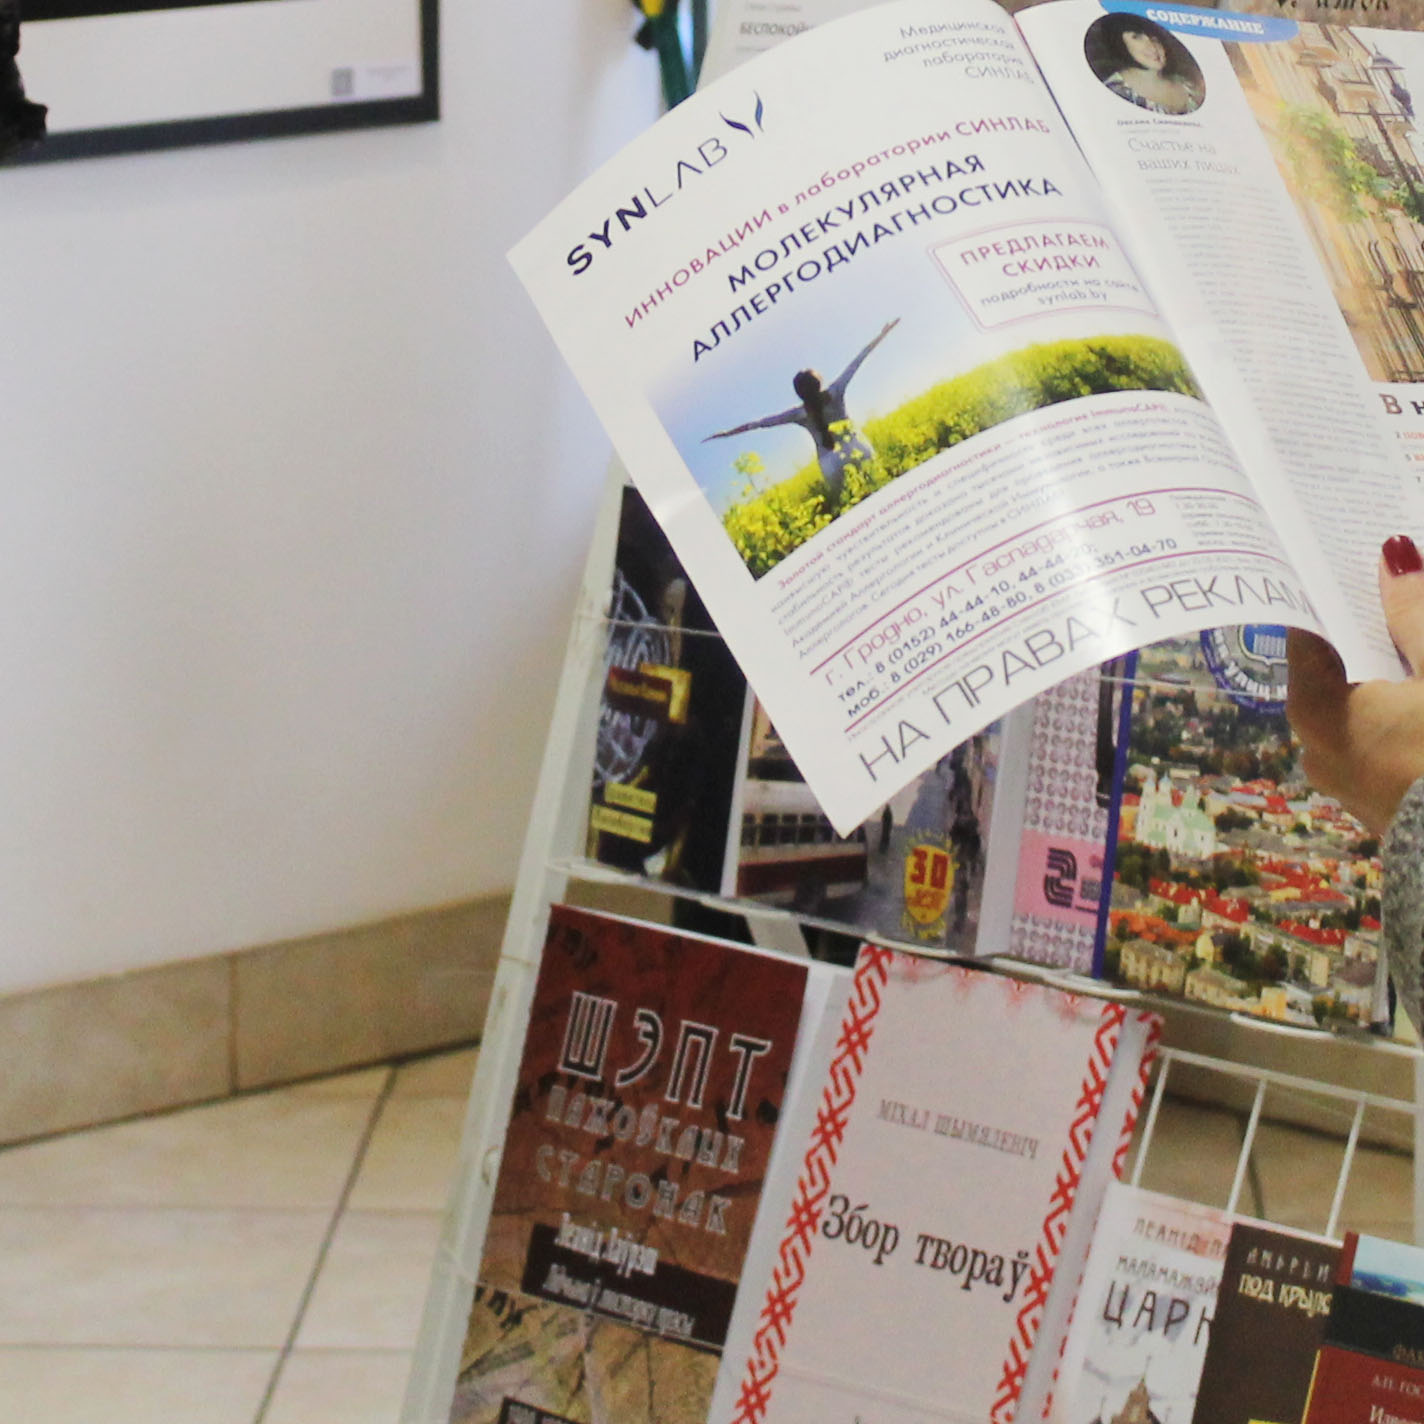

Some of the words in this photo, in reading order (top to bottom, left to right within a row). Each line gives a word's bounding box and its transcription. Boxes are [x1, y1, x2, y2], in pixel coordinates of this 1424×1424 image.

[1146, 8, 1265, 36] СОДЕРЖАНИЕ
[566, 137, 728, 276] SYNLAB
[624, 208, 773, 328] ИННОВАЦИИ
[777, 202, 790, 215] в
[794, 130, 951, 207] лаборатории
[954, 115, 1052, 138] СИНЛАБ
[727, 153, 987, 293] МОЛЕКУЛЯРНАЯ
[960, 232, 1111, 265] ПРЕДЛАГАЕМ
[691, 176, 1064, 363] АЛЛЕРГОДИАГНОСТИКА
[980, 279, 1080, 305] подробности
[1002, 254, 1101, 277] СКИДКИ
[1378, 393, 1403, 415] В
[778, 552, 825, 590] Золотой
[826, 513, 877, 554] стандарт
[842, 605, 929, 671] Гродно,
[931, 584, 965, 609] ул.
[1127, 496, 1157, 518] 19
[875, 661, 887, 674] 8
[888, 625, 938, 666] (0152)
[939, 582, 1016, 629] 44-44-10,
[890, 670, 903, 683] 8
[903, 642, 944, 676] (029)
[946, 590, 1033, 644] 166-48-80,
[1034, 581, 1045, 594] 8
[1095, 536, 1177, 569] 351-04-70
[859, 719, 931, 783] НА
[932, 597, 1138, 725] ПРАВАХ
[557, 990, 772, 1121] ШЭПТ
[535, 1143, 734, 1237] СТАРОНАК
[822, 1194, 899, 1266] Збор
[914, 1232, 1031, 1304] твораў
[1238, 1274, 1275, 1304] ПОД
